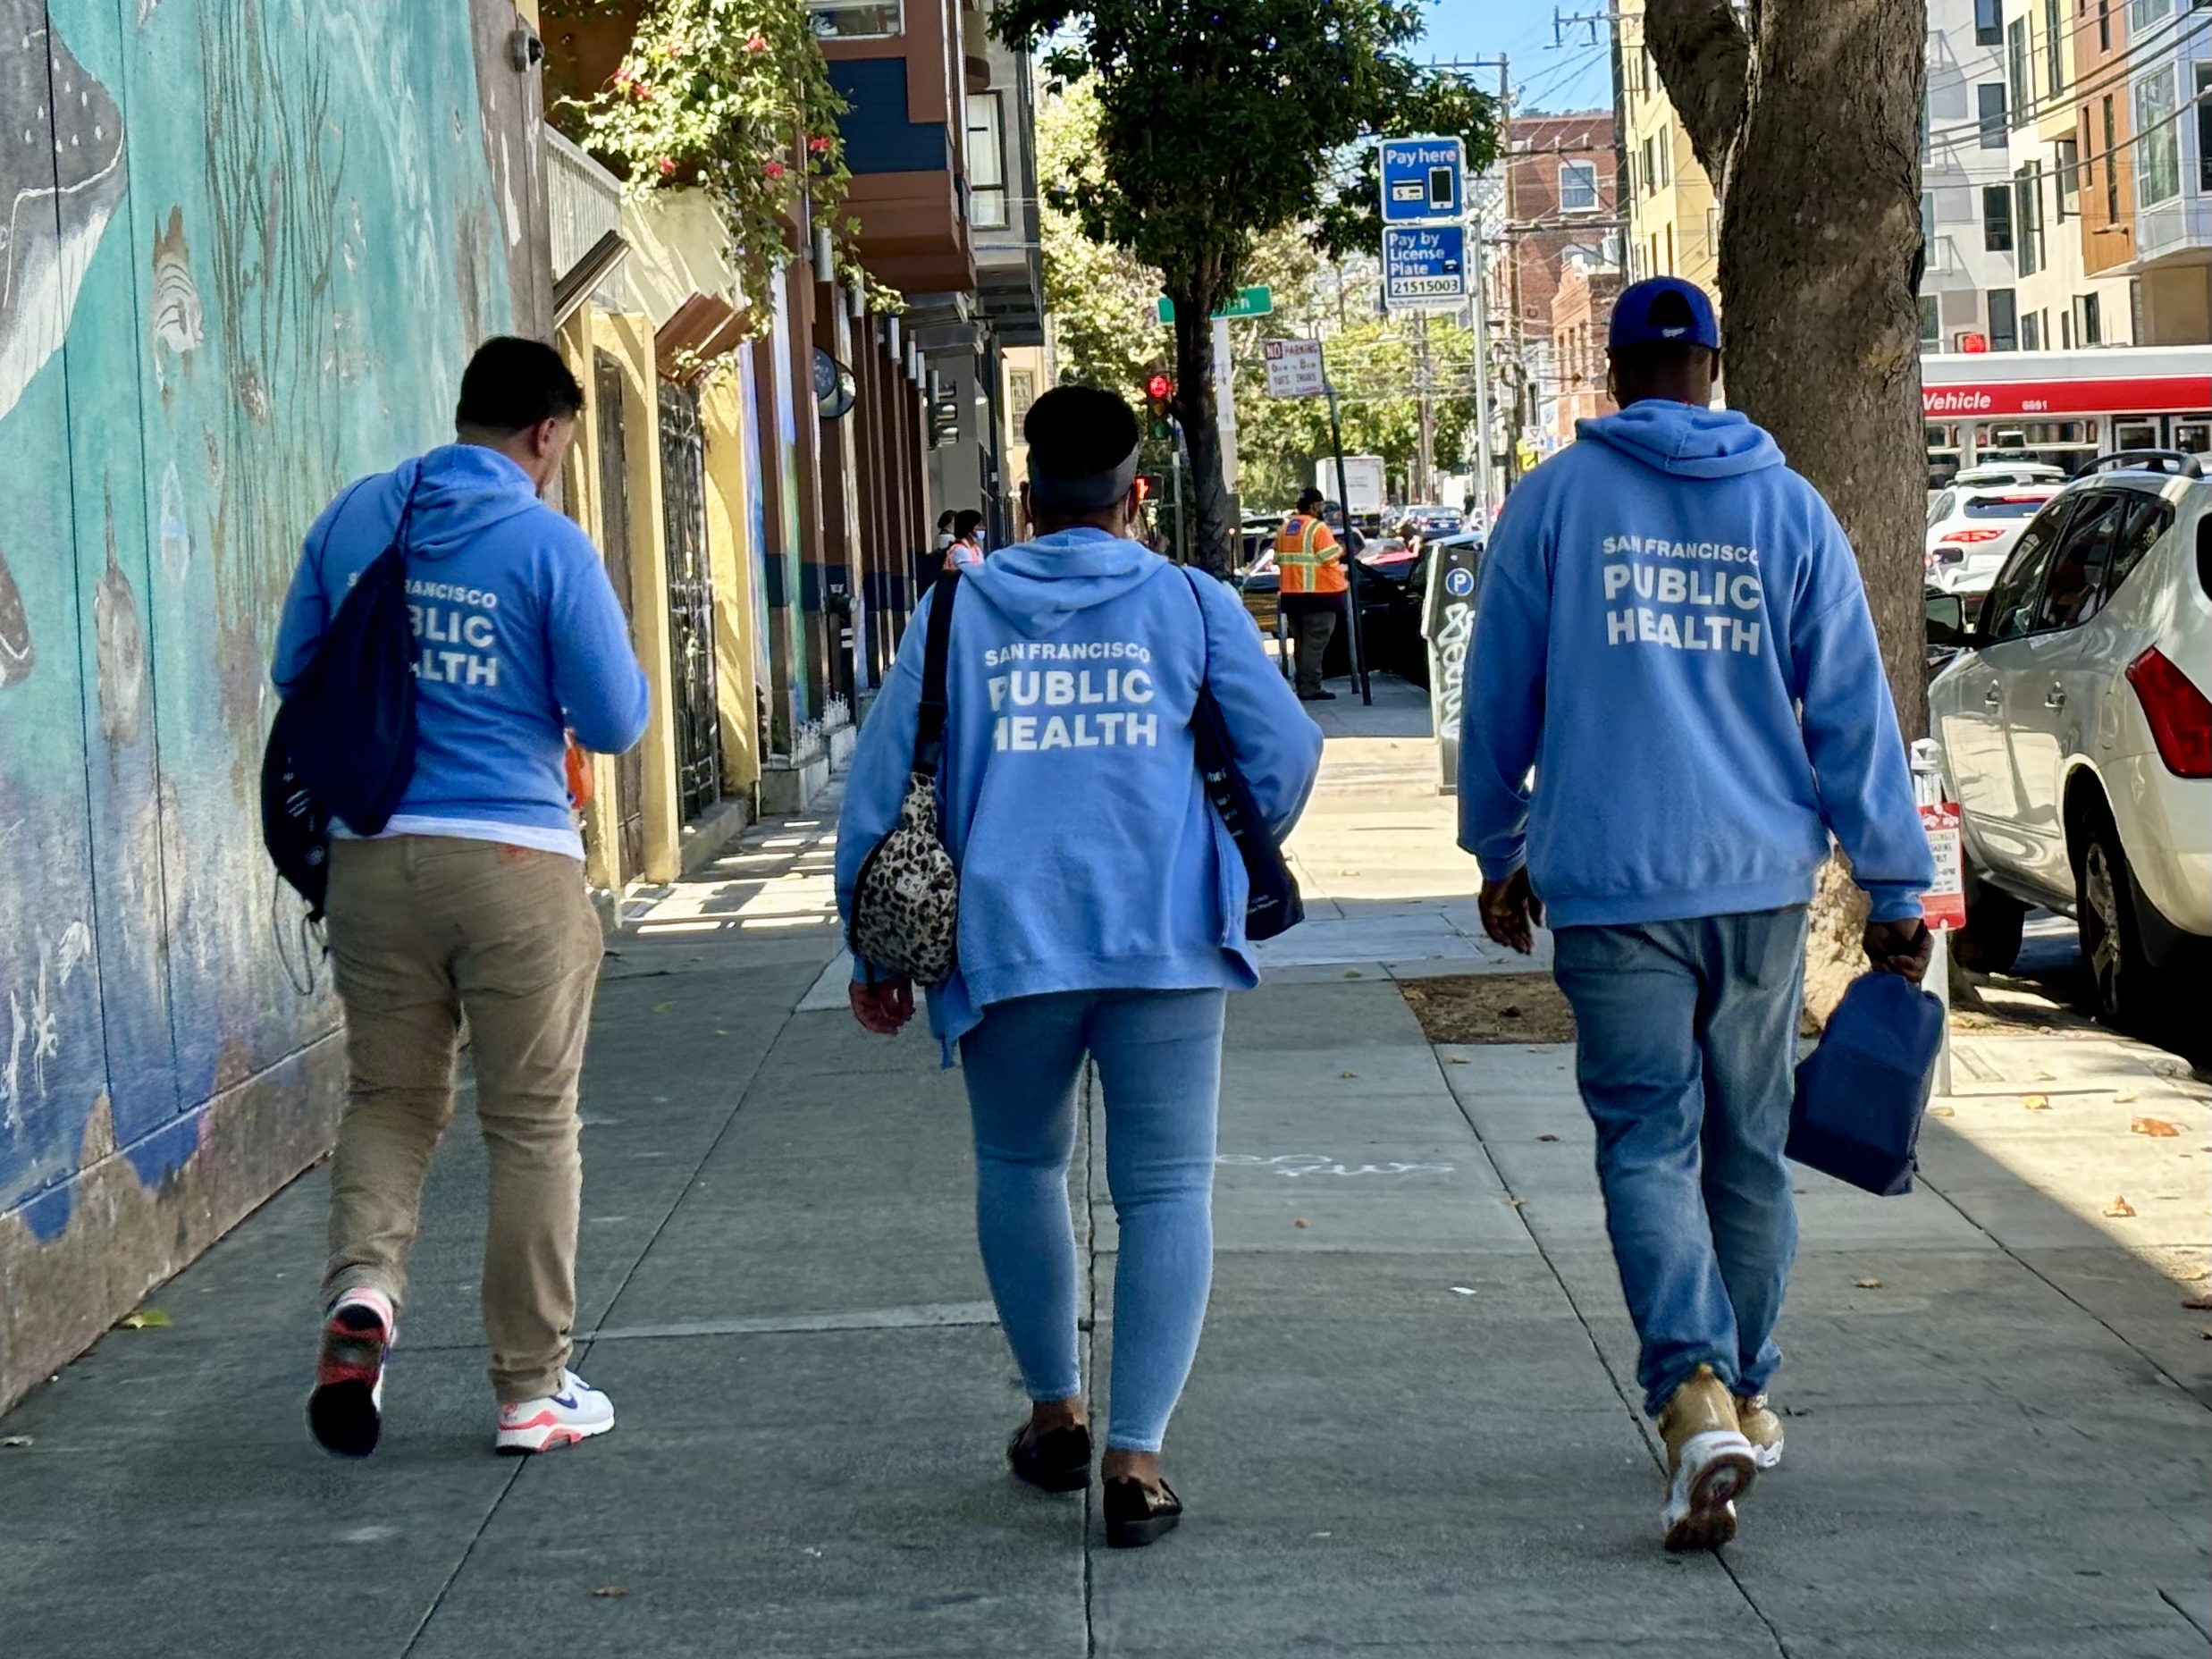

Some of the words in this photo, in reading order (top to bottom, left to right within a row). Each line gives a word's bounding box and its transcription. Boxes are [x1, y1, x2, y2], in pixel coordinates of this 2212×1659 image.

[1387, 149, 1417, 168] Pay
[1418, 147, 1456, 164] here
[1390, 232, 1417, 249] Pay
[1421, 232, 1440, 248] by
[1391, 248, 1445, 261] License
[1391, 261, 1428, 276] Plate
[1393, 280, 1459, 294] 21515003
[1266, 342, 1281, 358] NO
[1922, 391, 1992, 411] Vehicle
[1602, 535, 1641, 555] SAN
[1644, 538, 1760, 567] FRANCISCO
[405, 578, 498, 610] RANCISCO
[1603, 562, 1762, 611] PUBLIC
[407, 604, 494, 648] BLIC
[1607, 607, 1761, 656] HEALTH
[985, 642, 1024, 667] SAN
[1029, 641, 1151, 663] FRANCISCO
[408, 648, 497, 687] LTH
[988, 668, 1156, 712] PUBLIC
